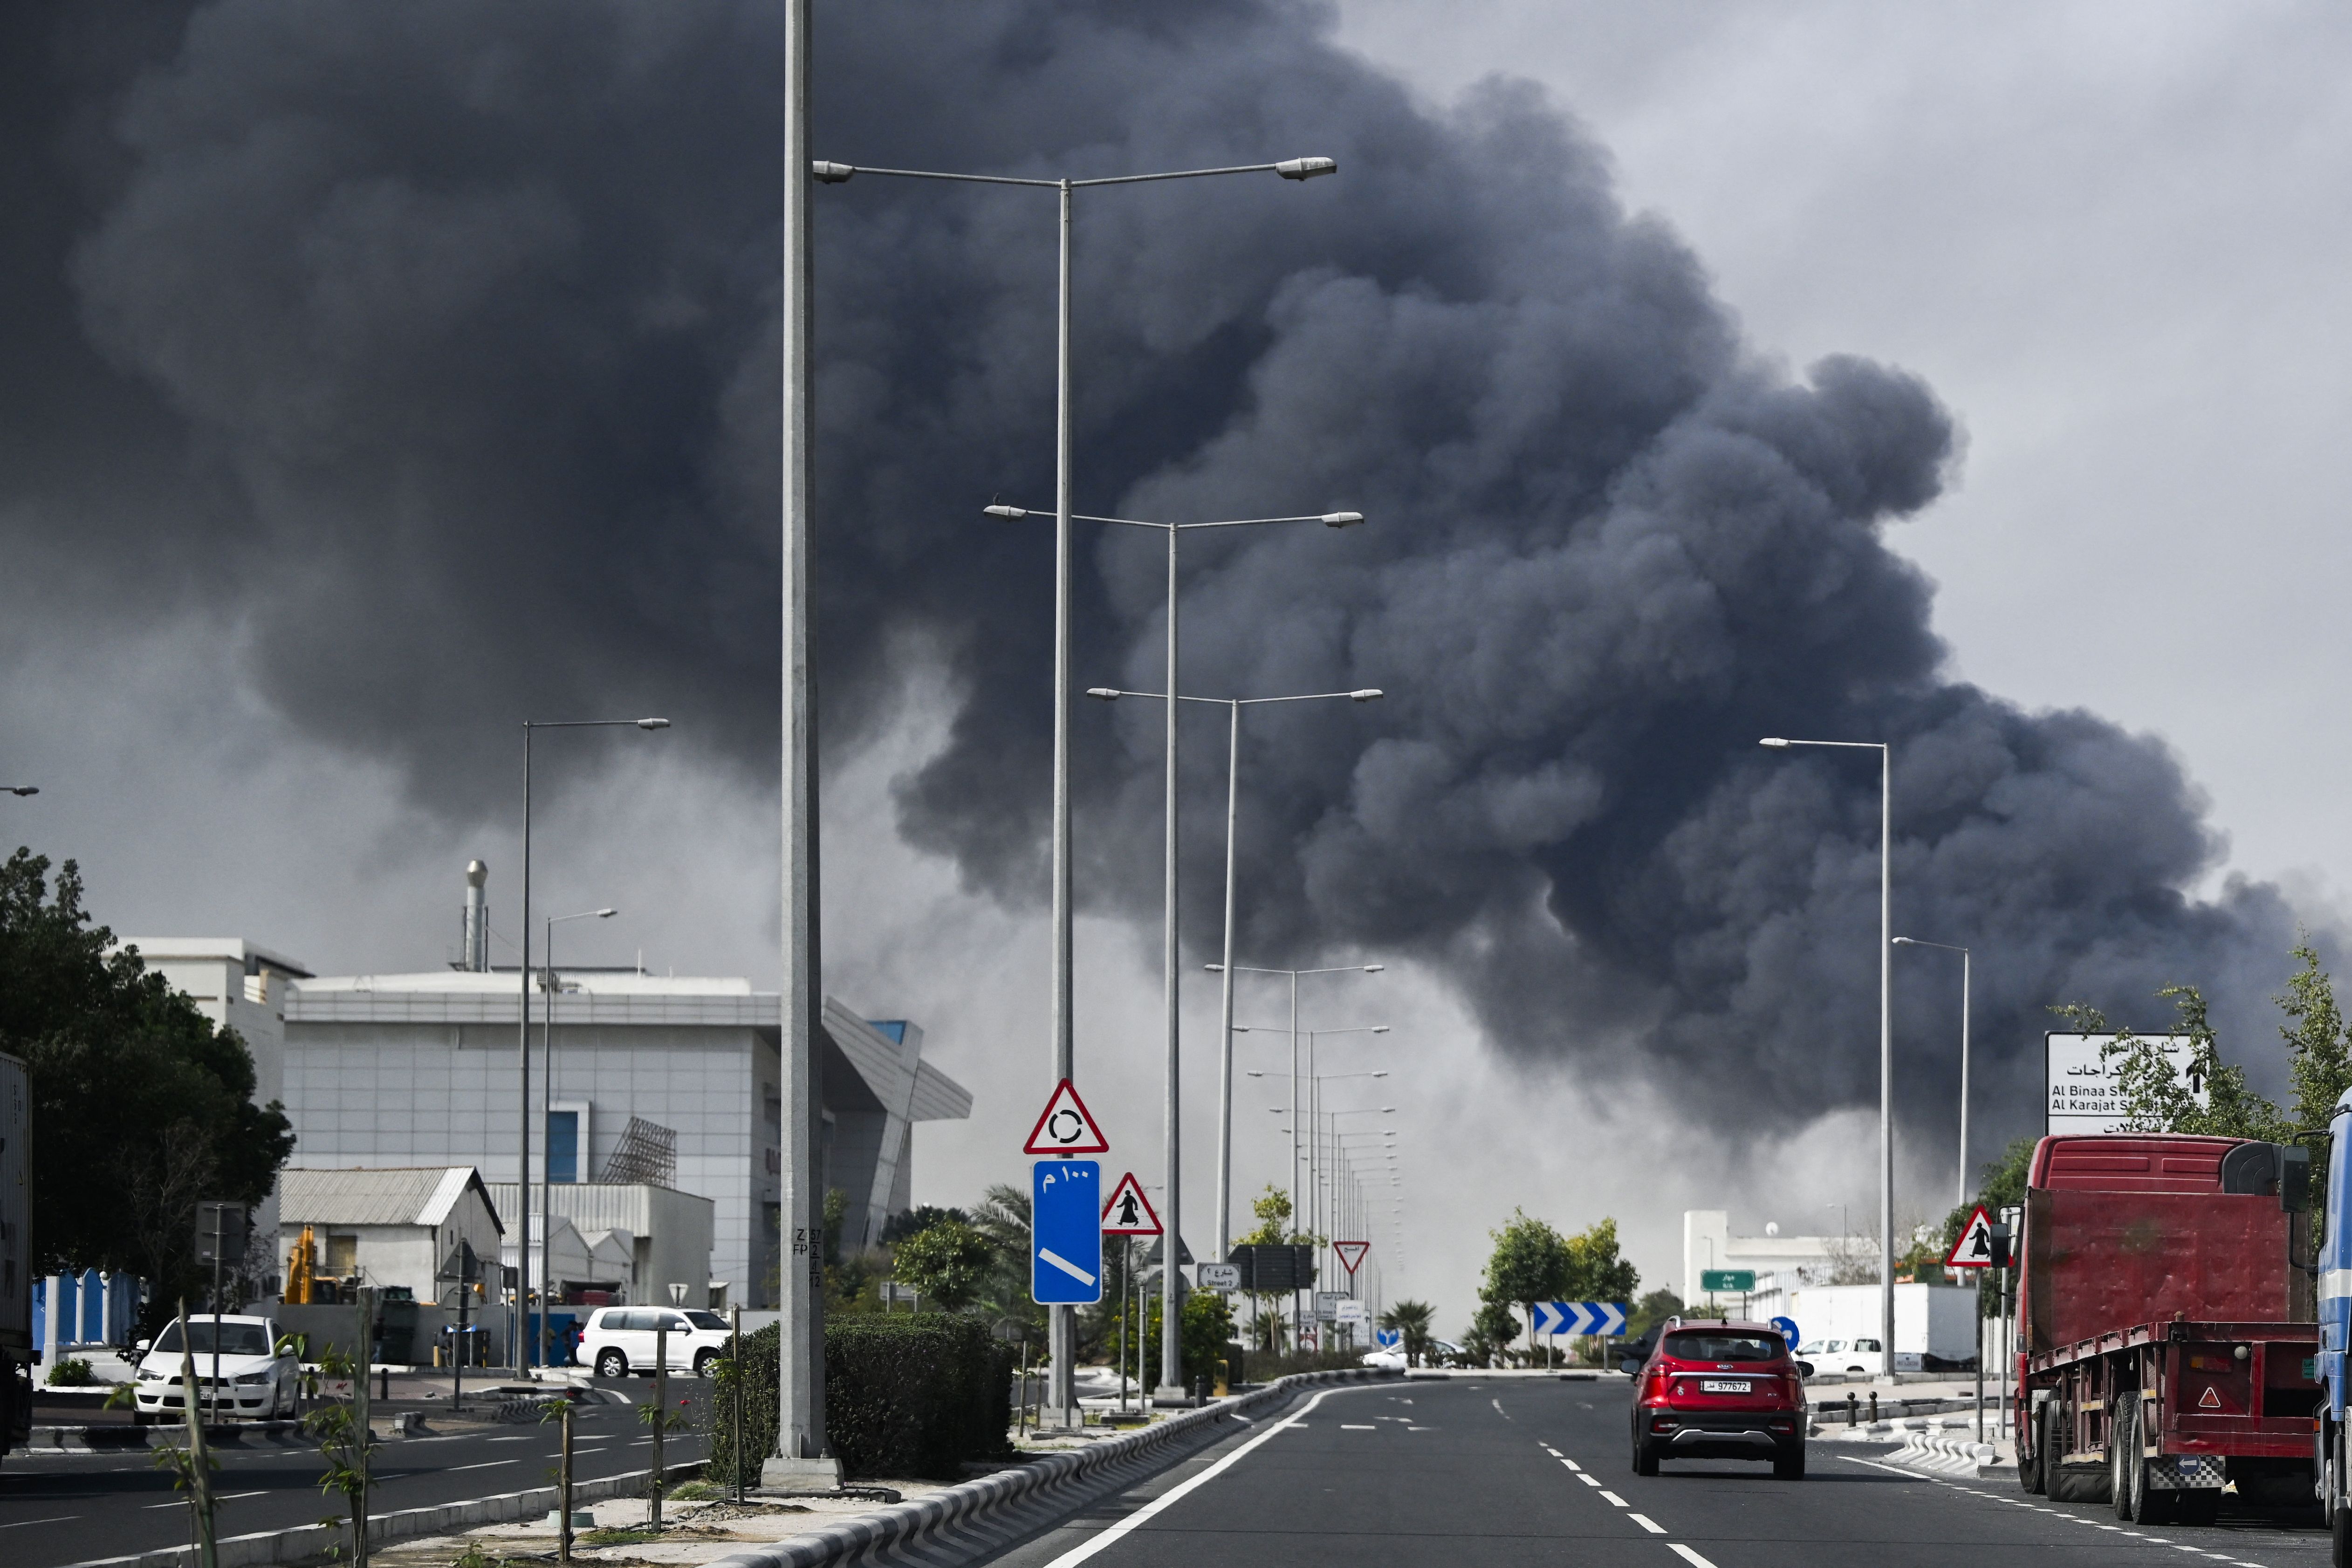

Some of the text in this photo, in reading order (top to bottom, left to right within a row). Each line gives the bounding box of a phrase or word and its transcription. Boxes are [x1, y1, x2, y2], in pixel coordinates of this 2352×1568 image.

[2052, 1085, 2065, 1096] Al
[2070, 1085, 2105, 1096] Binaa
[2052, 1099, 2065, 1110] Al
[2070, 1099, 2115, 1112] Karajat
[1042, 1165, 1089, 1194] ١٠٠ م
[797, 1229, 805, 1241] Z
[793, 1244, 808, 1255] FP
[1718, 1382, 1747, 1391] 977672
